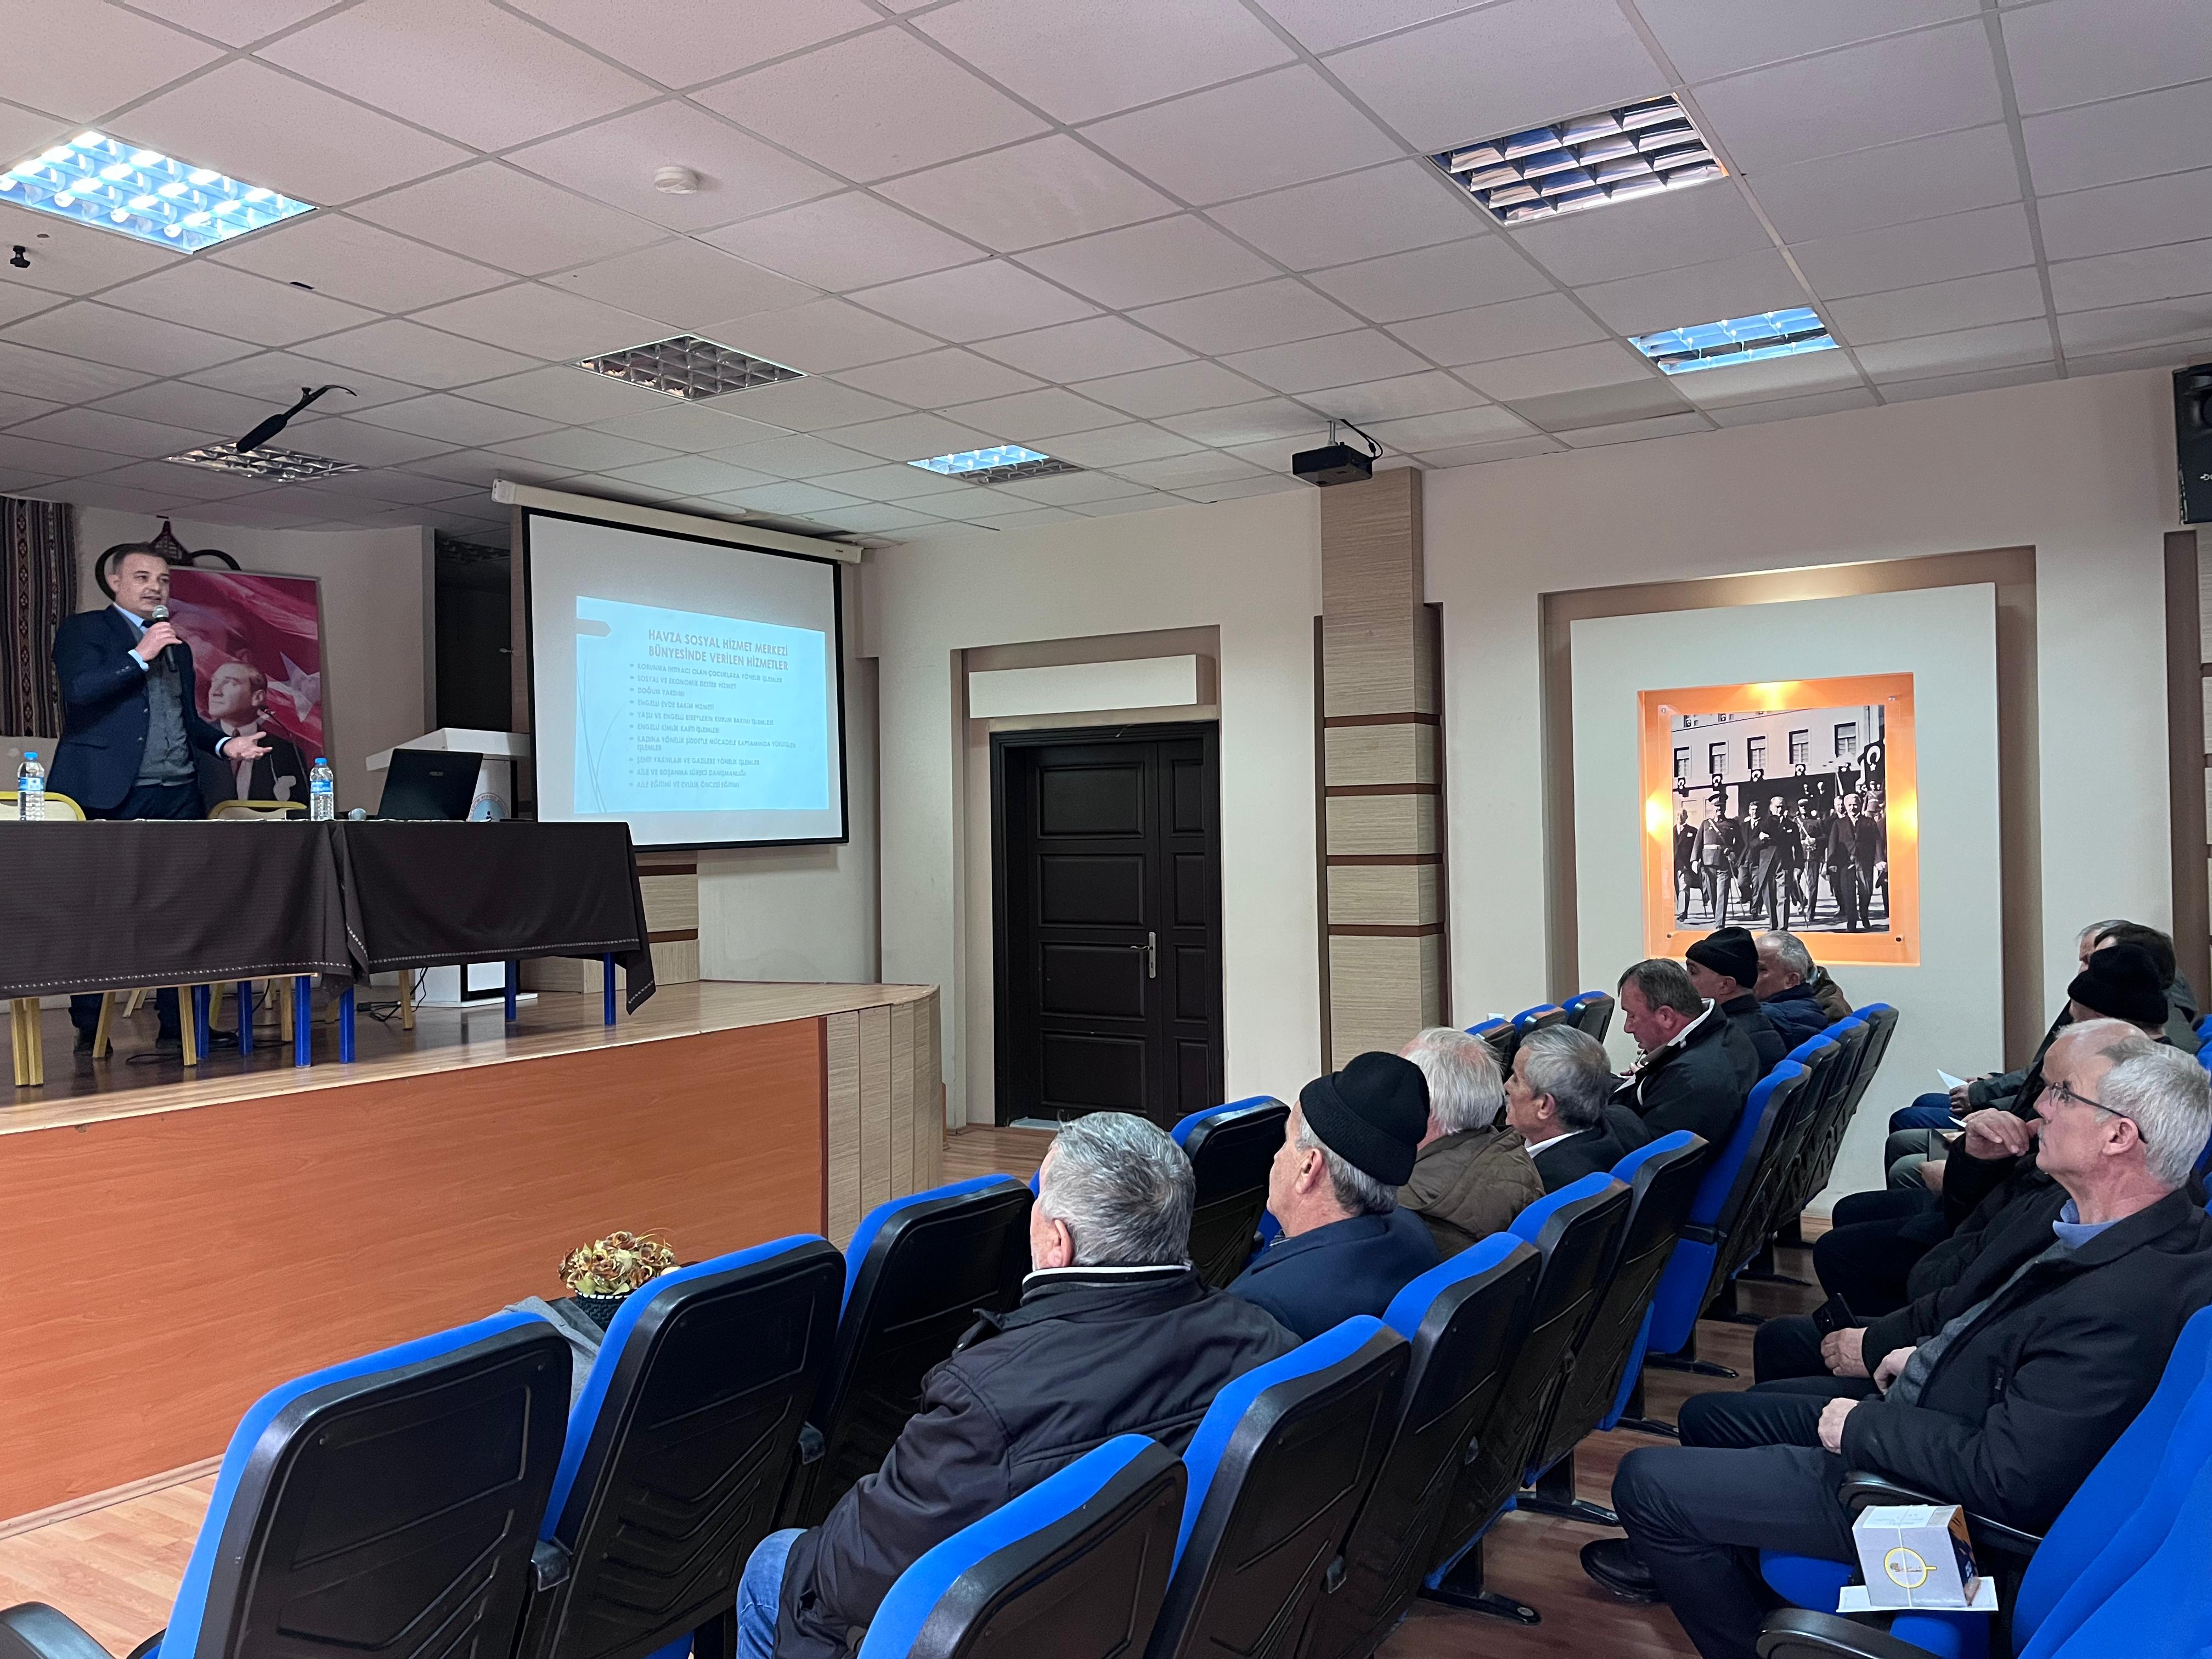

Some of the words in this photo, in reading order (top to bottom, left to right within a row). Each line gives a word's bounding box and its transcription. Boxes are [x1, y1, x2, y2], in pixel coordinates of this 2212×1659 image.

[648, 629, 682, 644] HAVZA
[685, 634, 720, 648] SOSYAL
[723, 637, 752, 652] HİZMET
[755, 644, 788, 656] MERKEZİ
[649, 644, 707, 662] BÜNYESİNDE
[710, 652, 744, 666] VERİLEN
[747, 655, 788, 670] HİZMETLER
[637, 663, 667, 672] KORUNMA
[708, 670, 740, 679] ÇOCUKLARA
[637, 686, 660, 695] DOĞUM
[637, 712, 653, 720] YAŞLI
[709, 738, 737, 746] MÜCADELE
[659, 769, 688, 777] BOŞANMA
[689, 768, 708, 776] SÜRECİ
[708, 769, 746, 777] DANIŞMANLIĞI
[636, 780, 649, 788] AİLE
